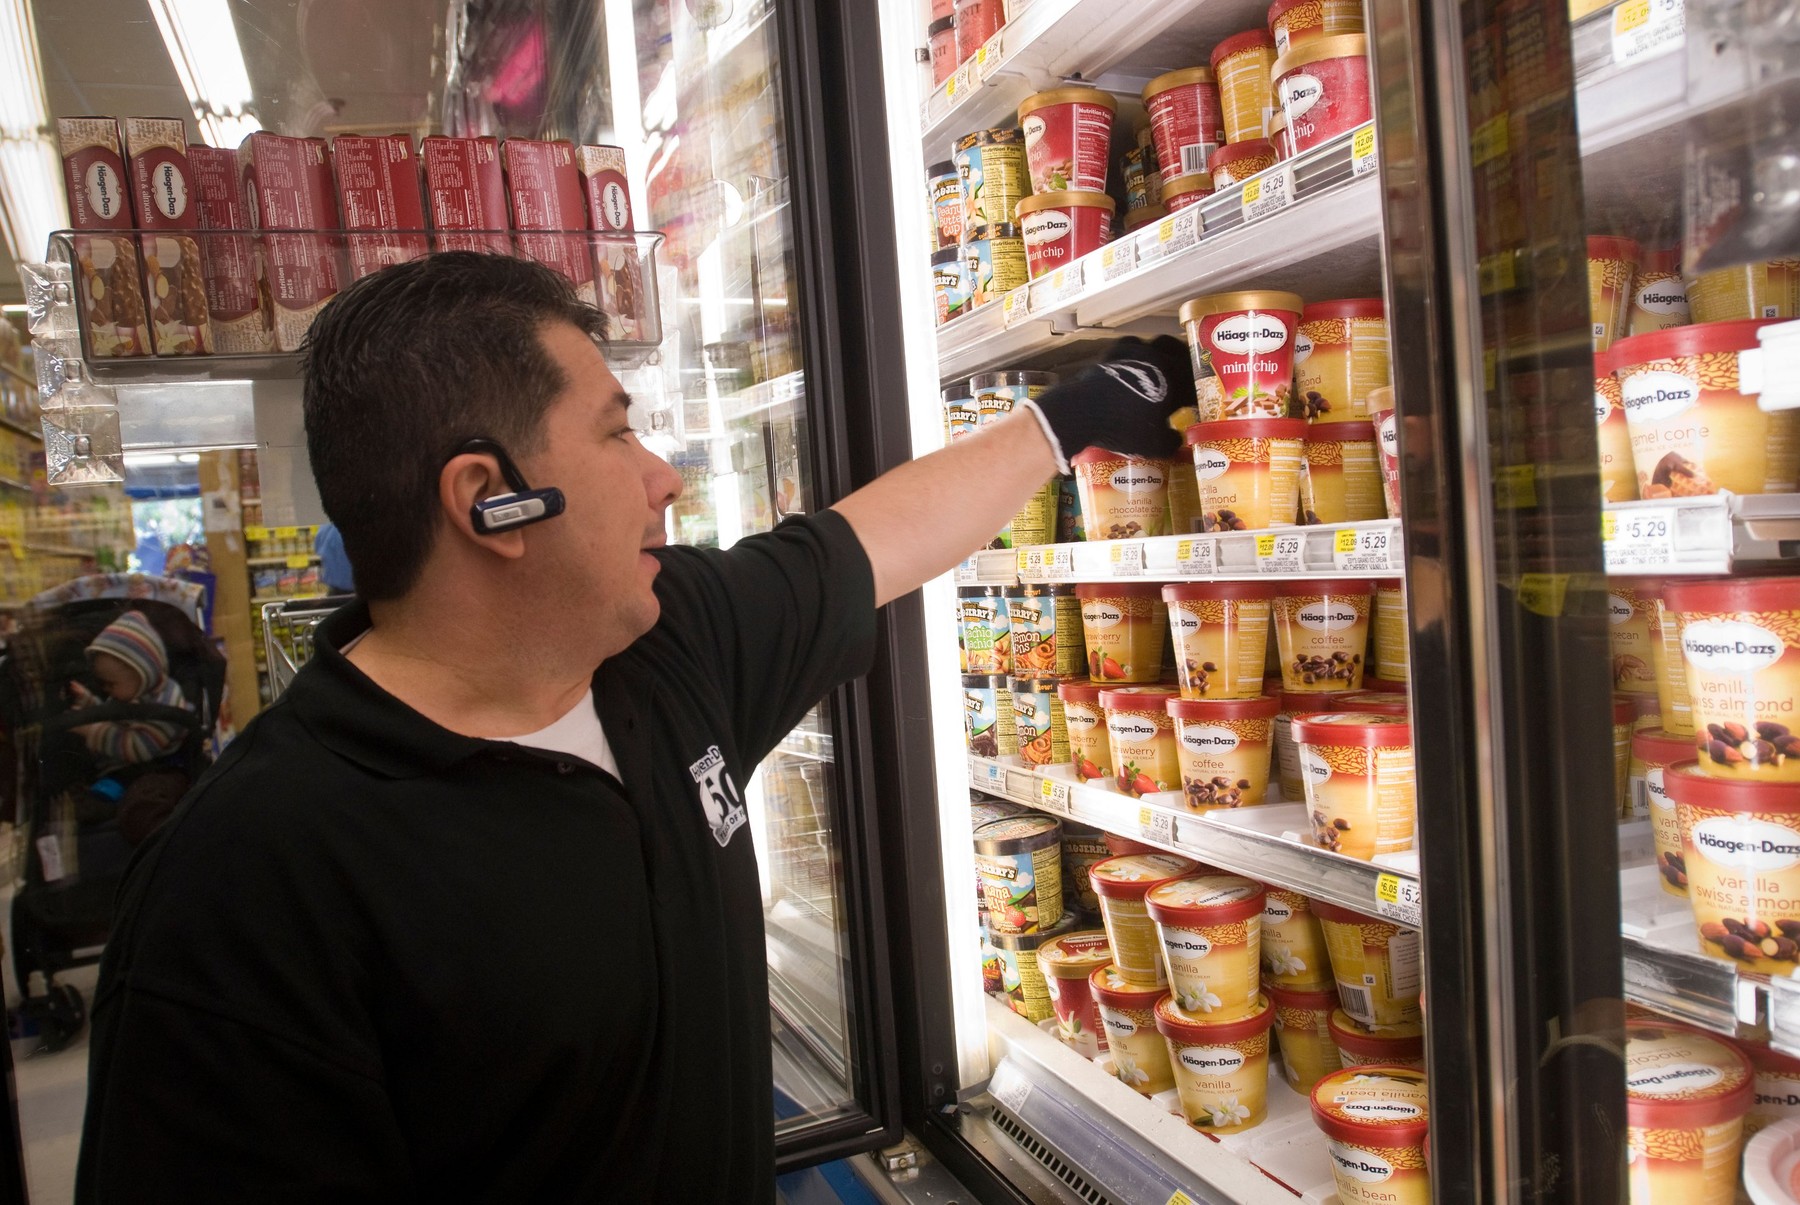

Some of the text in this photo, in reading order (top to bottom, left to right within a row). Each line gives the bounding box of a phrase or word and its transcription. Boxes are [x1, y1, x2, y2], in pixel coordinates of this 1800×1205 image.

[1294, 122, 1315, 140] chip
[1355, 134, 1374, 147] $12.09
[70, 158, 81, 182] vanilla
[138, 157, 147, 182] vanilla
[97, 165, 111, 216] Häagen-Dazs
[164, 165, 177, 216] Häagen-Dazs
[1263, 175, 1284, 194] $5.29
[75, 191, 87, 224] almonds
[142, 191, 154, 224] almonds
[611, 185, 621, 227] Häagen-Dazs
[1175, 216, 1194, 232] $5.29
[1042, 247, 1065, 259] chip
[278, 267, 288, 299] Nutrition
[287, 278, 295, 299] Facts
[1217, 328, 1284, 342] Häagen-Dazs
[1222, 360, 1279, 375] mint chip
[1664, 426, 1710, 442] cone
[1114, 475, 1162, 487] Häagen-Dazs
[1109, 505, 1148, 515] chocolate
[1626, 520, 1667, 539] $5.29
[1277, 541, 1299, 554] $5.29
[1341, 538, 1357, 546] $12.09
[1361, 536, 1387, 549] $5.29
[1192, 546, 1211, 558] $5.29
[1301, 612, 1355, 623] Häagen-Dazs
[1311, 635, 1345, 645] coffee
[1686, 639, 1776, 658] Häagen-Dazs
[1701, 680, 1752, 694] vanill
[1183, 735, 1236, 749] Häagen-Dazs
[1192, 758, 1225, 770] coffee
[729, 814, 739, 825] OF
[1381, 882, 1398, 895] $6.05
[1717, 875, 1780, 894] vanlla
[1696, 885, 1733, 905] swiss
[1182, 1054, 1241, 1069] Häagen-Dazs
[1195, 1078, 1232, 1090] vanilla
[1346, 1104, 1416, 1115] Häagen-Dazs
[1362, 1187, 1397, 1202] bean
